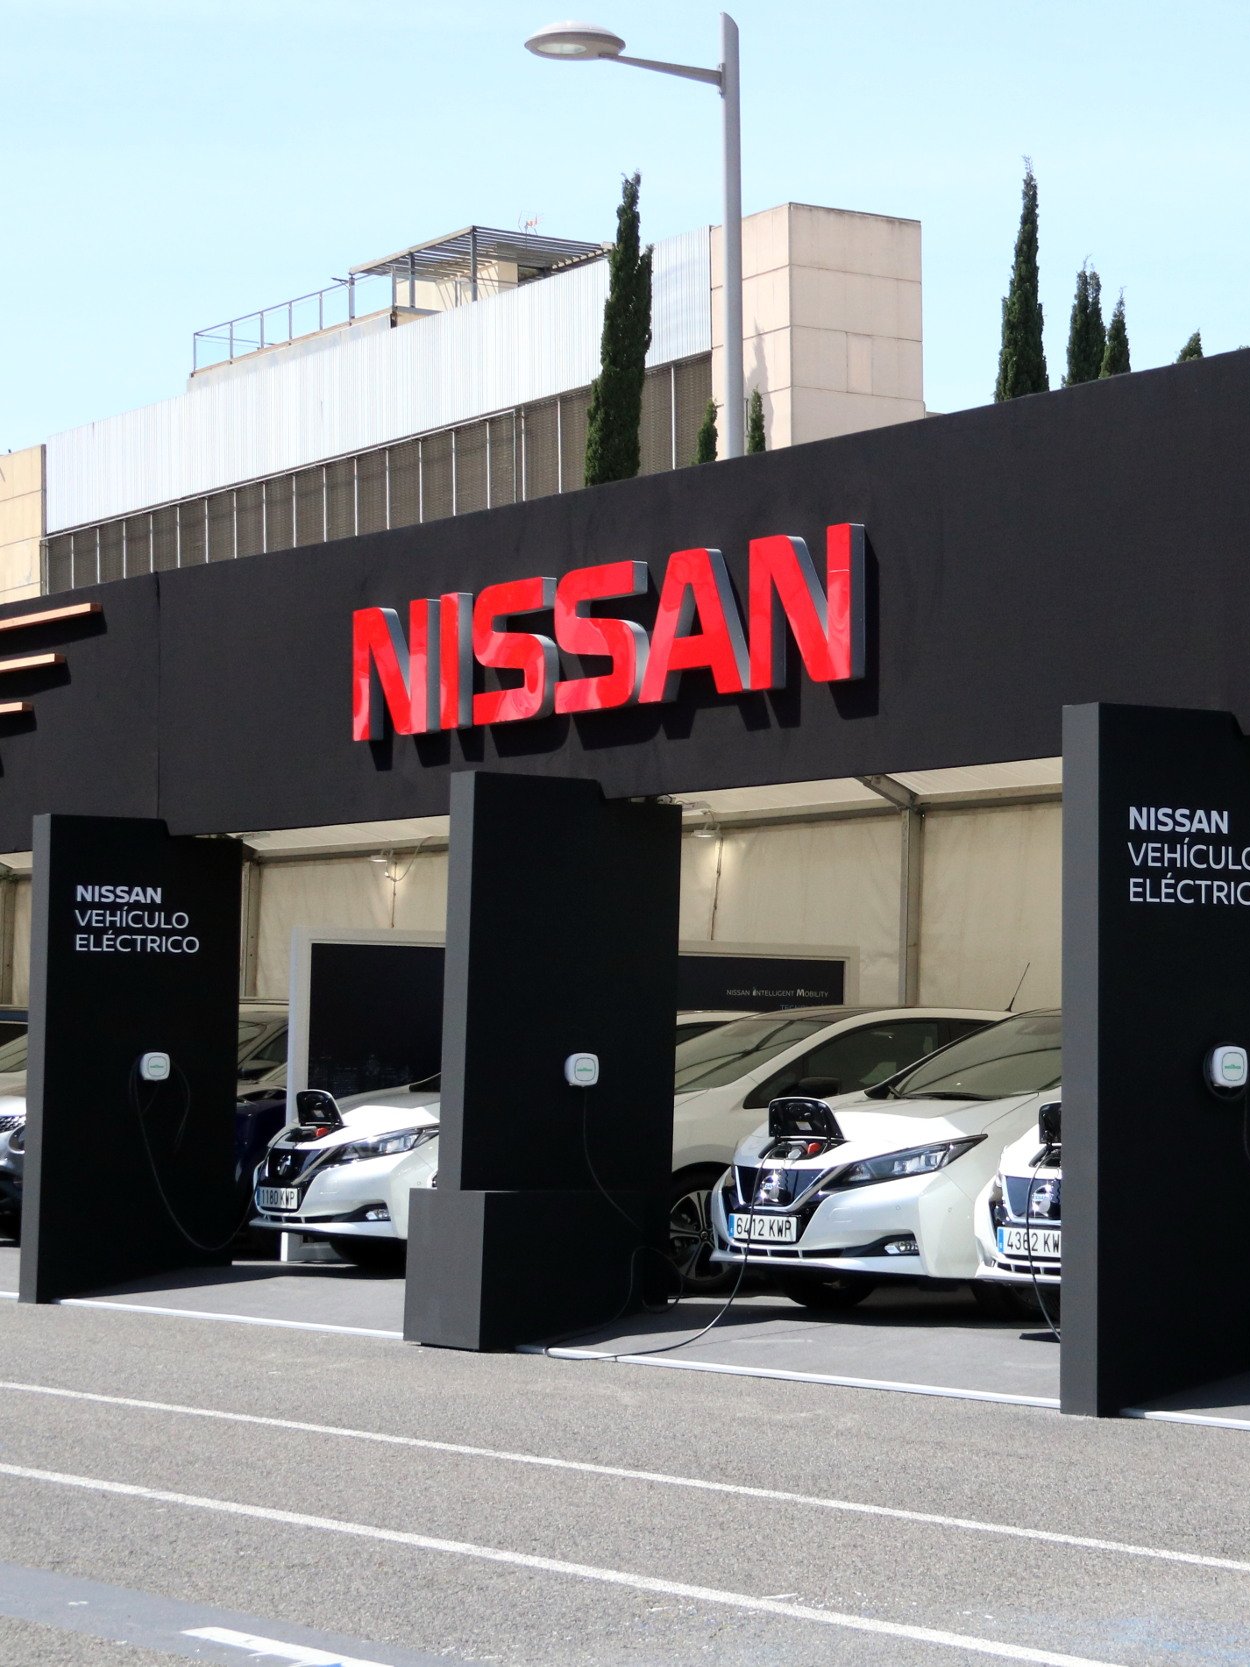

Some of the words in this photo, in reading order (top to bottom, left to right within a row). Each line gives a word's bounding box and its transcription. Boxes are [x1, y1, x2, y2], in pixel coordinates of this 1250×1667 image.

[352, 522, 864, 741] NISSAN
[1129, 806, 1229, 834] NISSAN
[76, 885, 162, 904] NISSAN
[75, 906, 189, 929] VEHÍCULO
[75, 930, 200, 953] ELÉCTRICO
[796, 988, 829, 998] MOBILITY
[262, 1190, 279, 1205] 1180
[736, 1218, 765, 1236] 6412
[1043, 1232, 1060, 1253] KW
